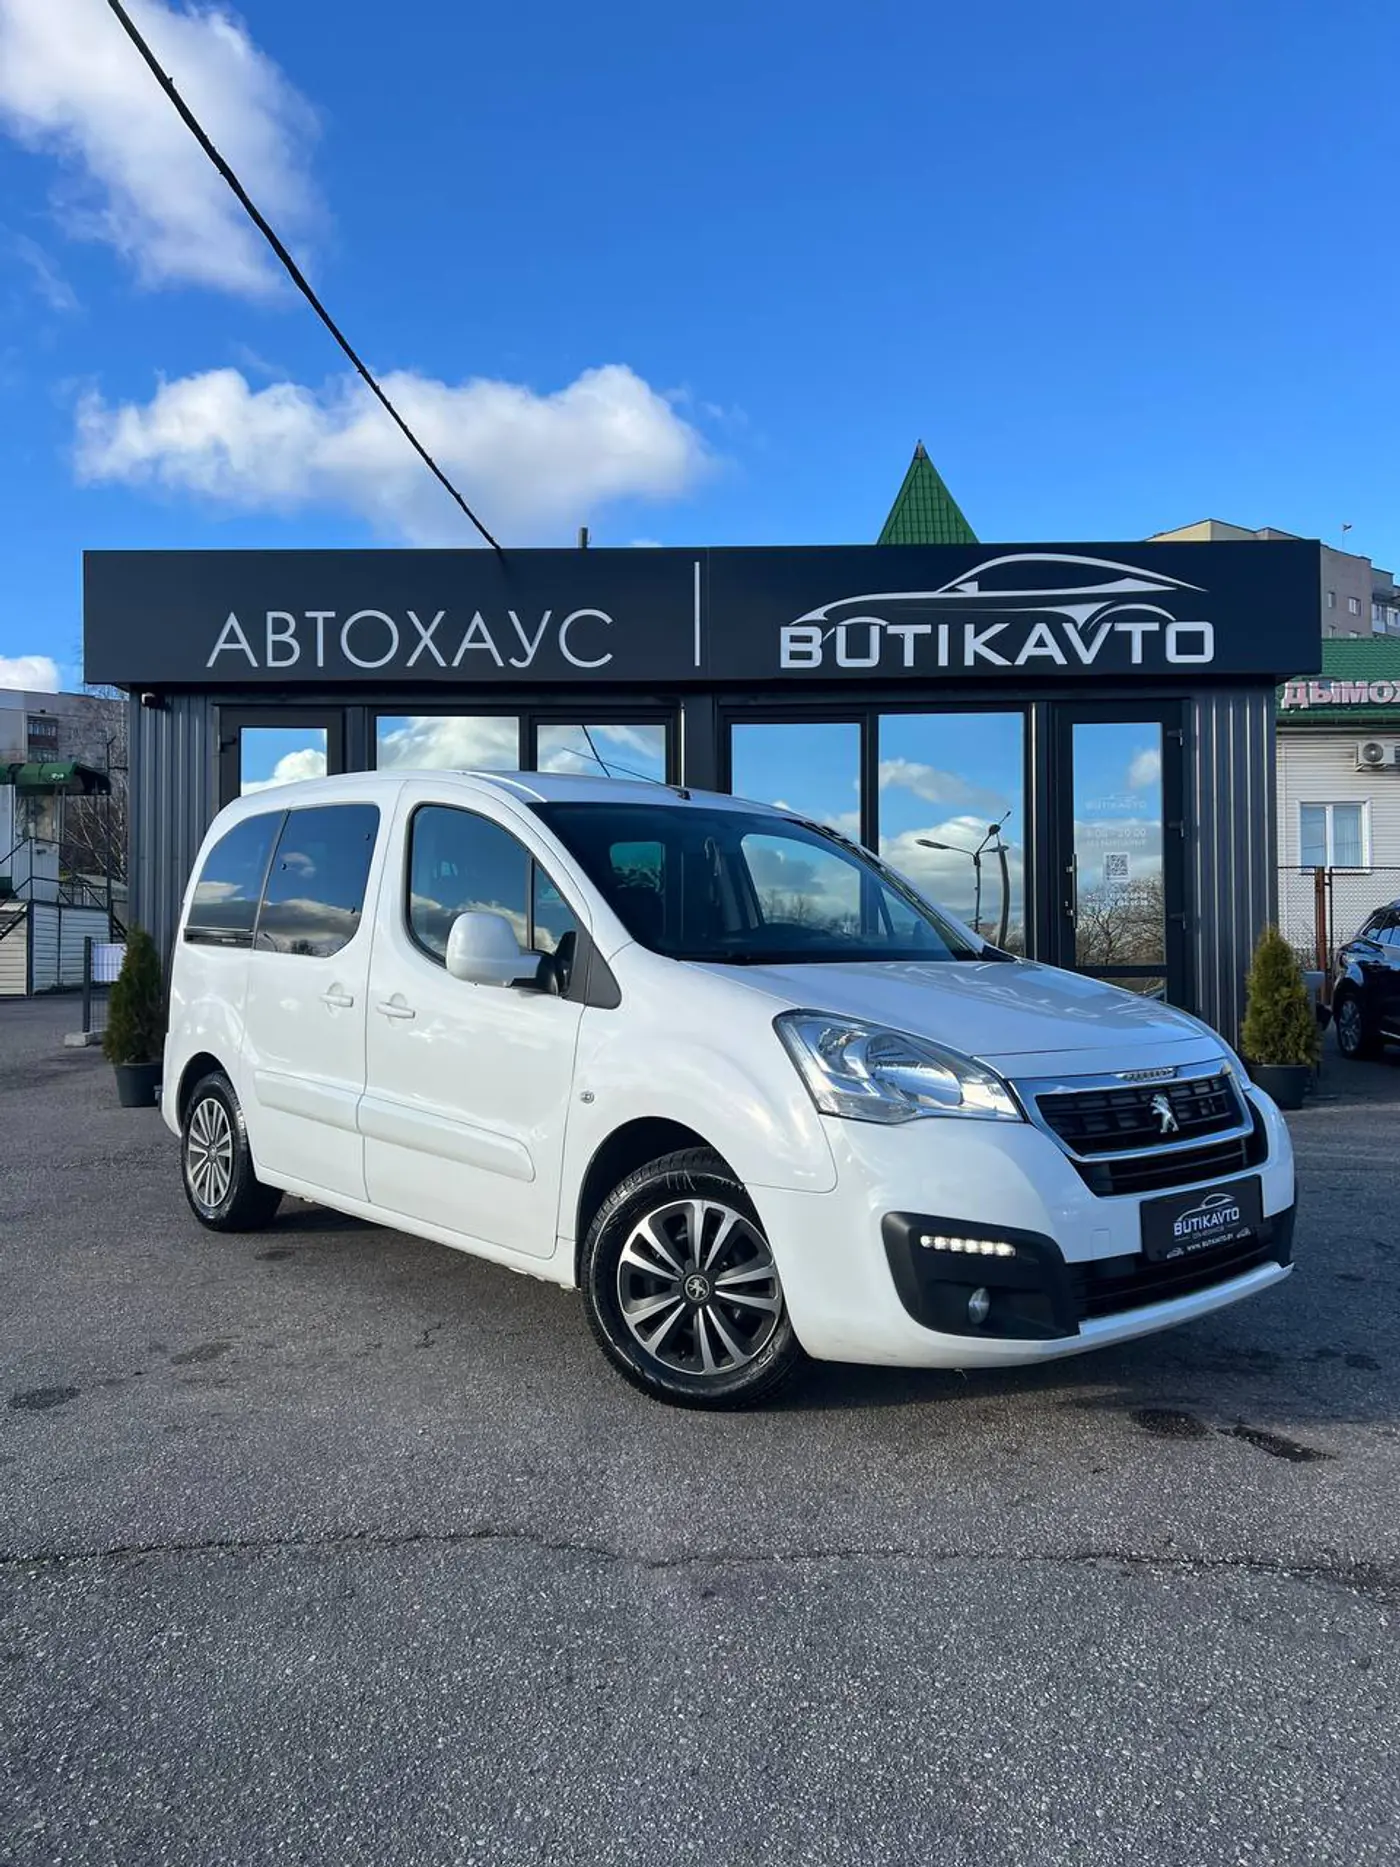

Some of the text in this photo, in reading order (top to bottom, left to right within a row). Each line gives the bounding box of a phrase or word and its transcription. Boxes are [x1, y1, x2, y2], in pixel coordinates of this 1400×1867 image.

[206, 609, 613, 667] АВТОХАУС
[780, 621, 1214, 669] BUTIKAVTO
[1173, 1207, 1240, 1236] BUTIKAVTO
